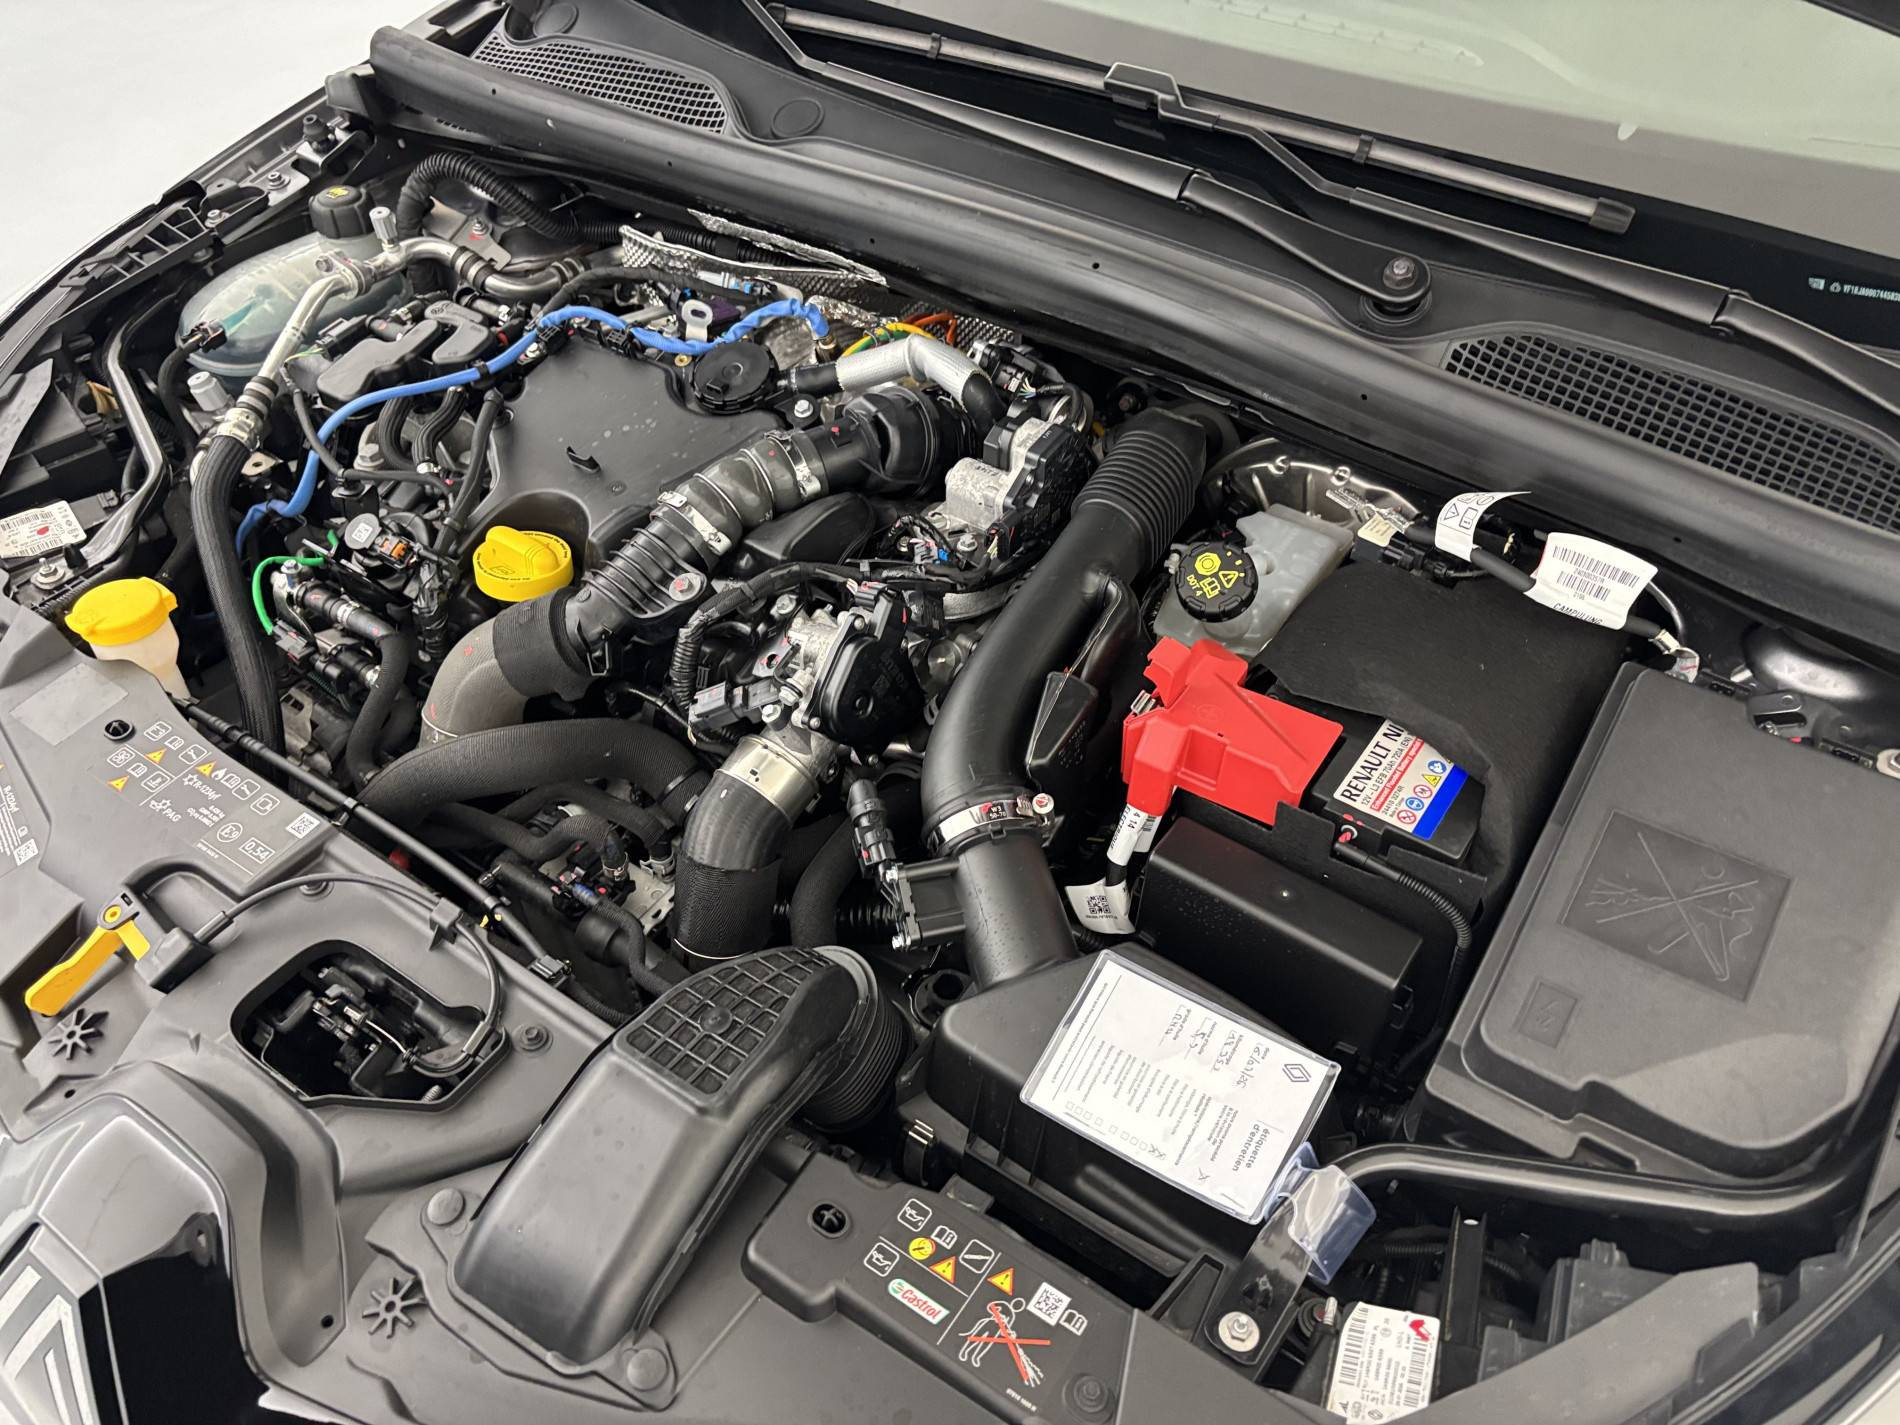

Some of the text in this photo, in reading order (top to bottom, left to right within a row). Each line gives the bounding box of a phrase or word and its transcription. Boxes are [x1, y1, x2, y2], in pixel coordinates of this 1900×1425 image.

[1186, 574, 1201, 590] DOT
[1341, 741, 1391, 802] RENAULT
[1360, 794, 1372, 806] 12V
[1375, 771, 1387, 785] EFB
[1382, 757, 1396, 774] 70Ah
[164, 808, 182, 823] PAG
[246, 840, 269, 861] 0,54
[1230, 1122, 1261, 1173] d'entretien
[1242, 1126, 1270, 1170] étiquette
[900, 1288, 942, 1319] Castrol
